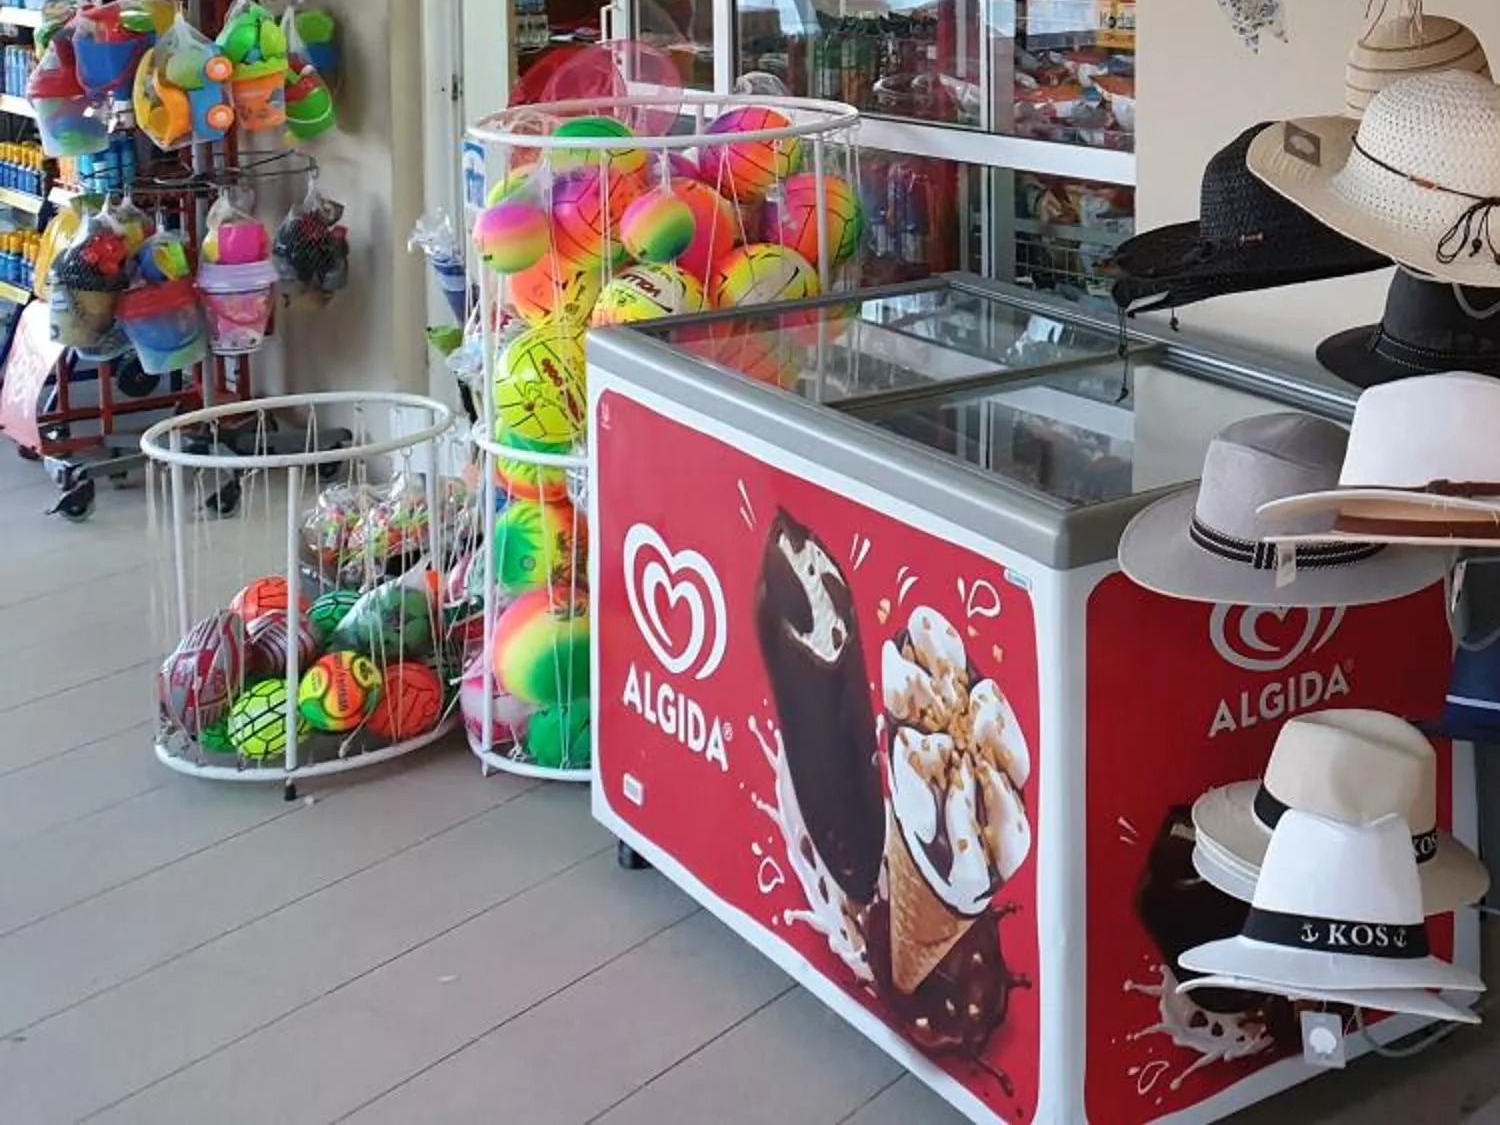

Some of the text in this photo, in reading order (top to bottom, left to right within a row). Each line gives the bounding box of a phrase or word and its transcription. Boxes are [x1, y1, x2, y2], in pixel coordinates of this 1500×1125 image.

[623, 661, 729, 772] ALGIDA
[1207, 662, 1350, 739] ALGIDA
[1327, 923, 1389, 947] KOS
